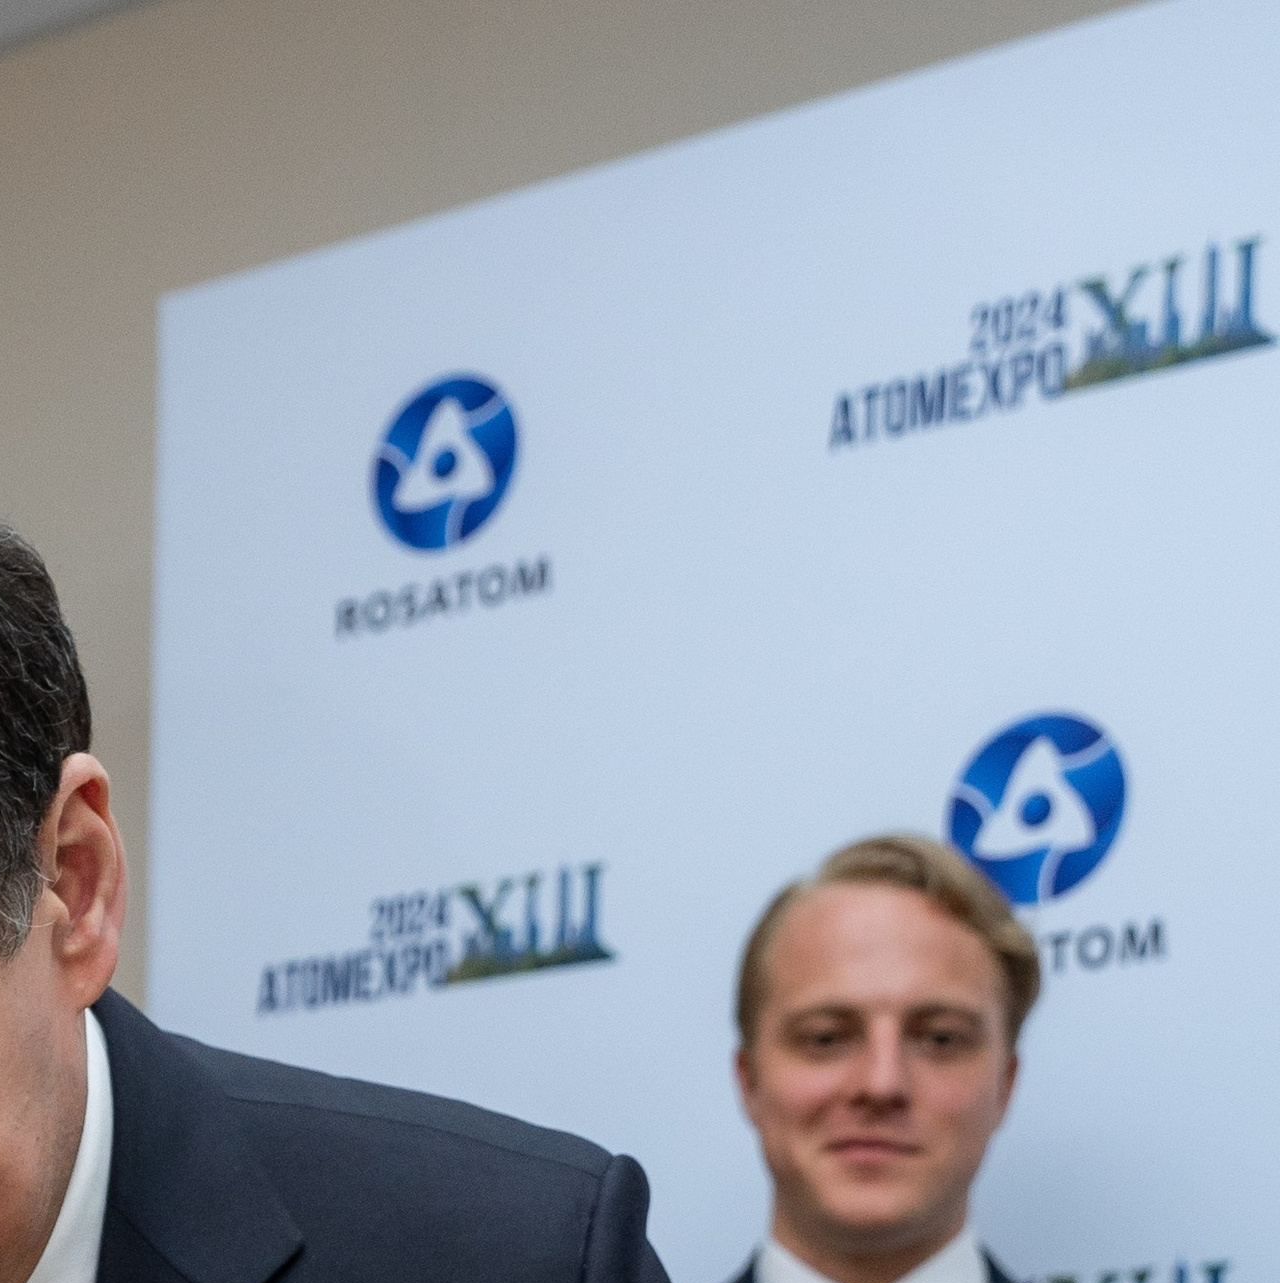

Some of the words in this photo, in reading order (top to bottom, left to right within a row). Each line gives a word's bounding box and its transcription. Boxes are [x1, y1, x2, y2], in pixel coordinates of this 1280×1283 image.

[969, 285, 1066, 355] 2024
[827, 340, 1066, 456] ATOMEXPO
[334, 554, 554, 638] ROSATOM
[370, 889, 449, 946] 2024
[257, 937, 448, 1018] ATOMEXPO
